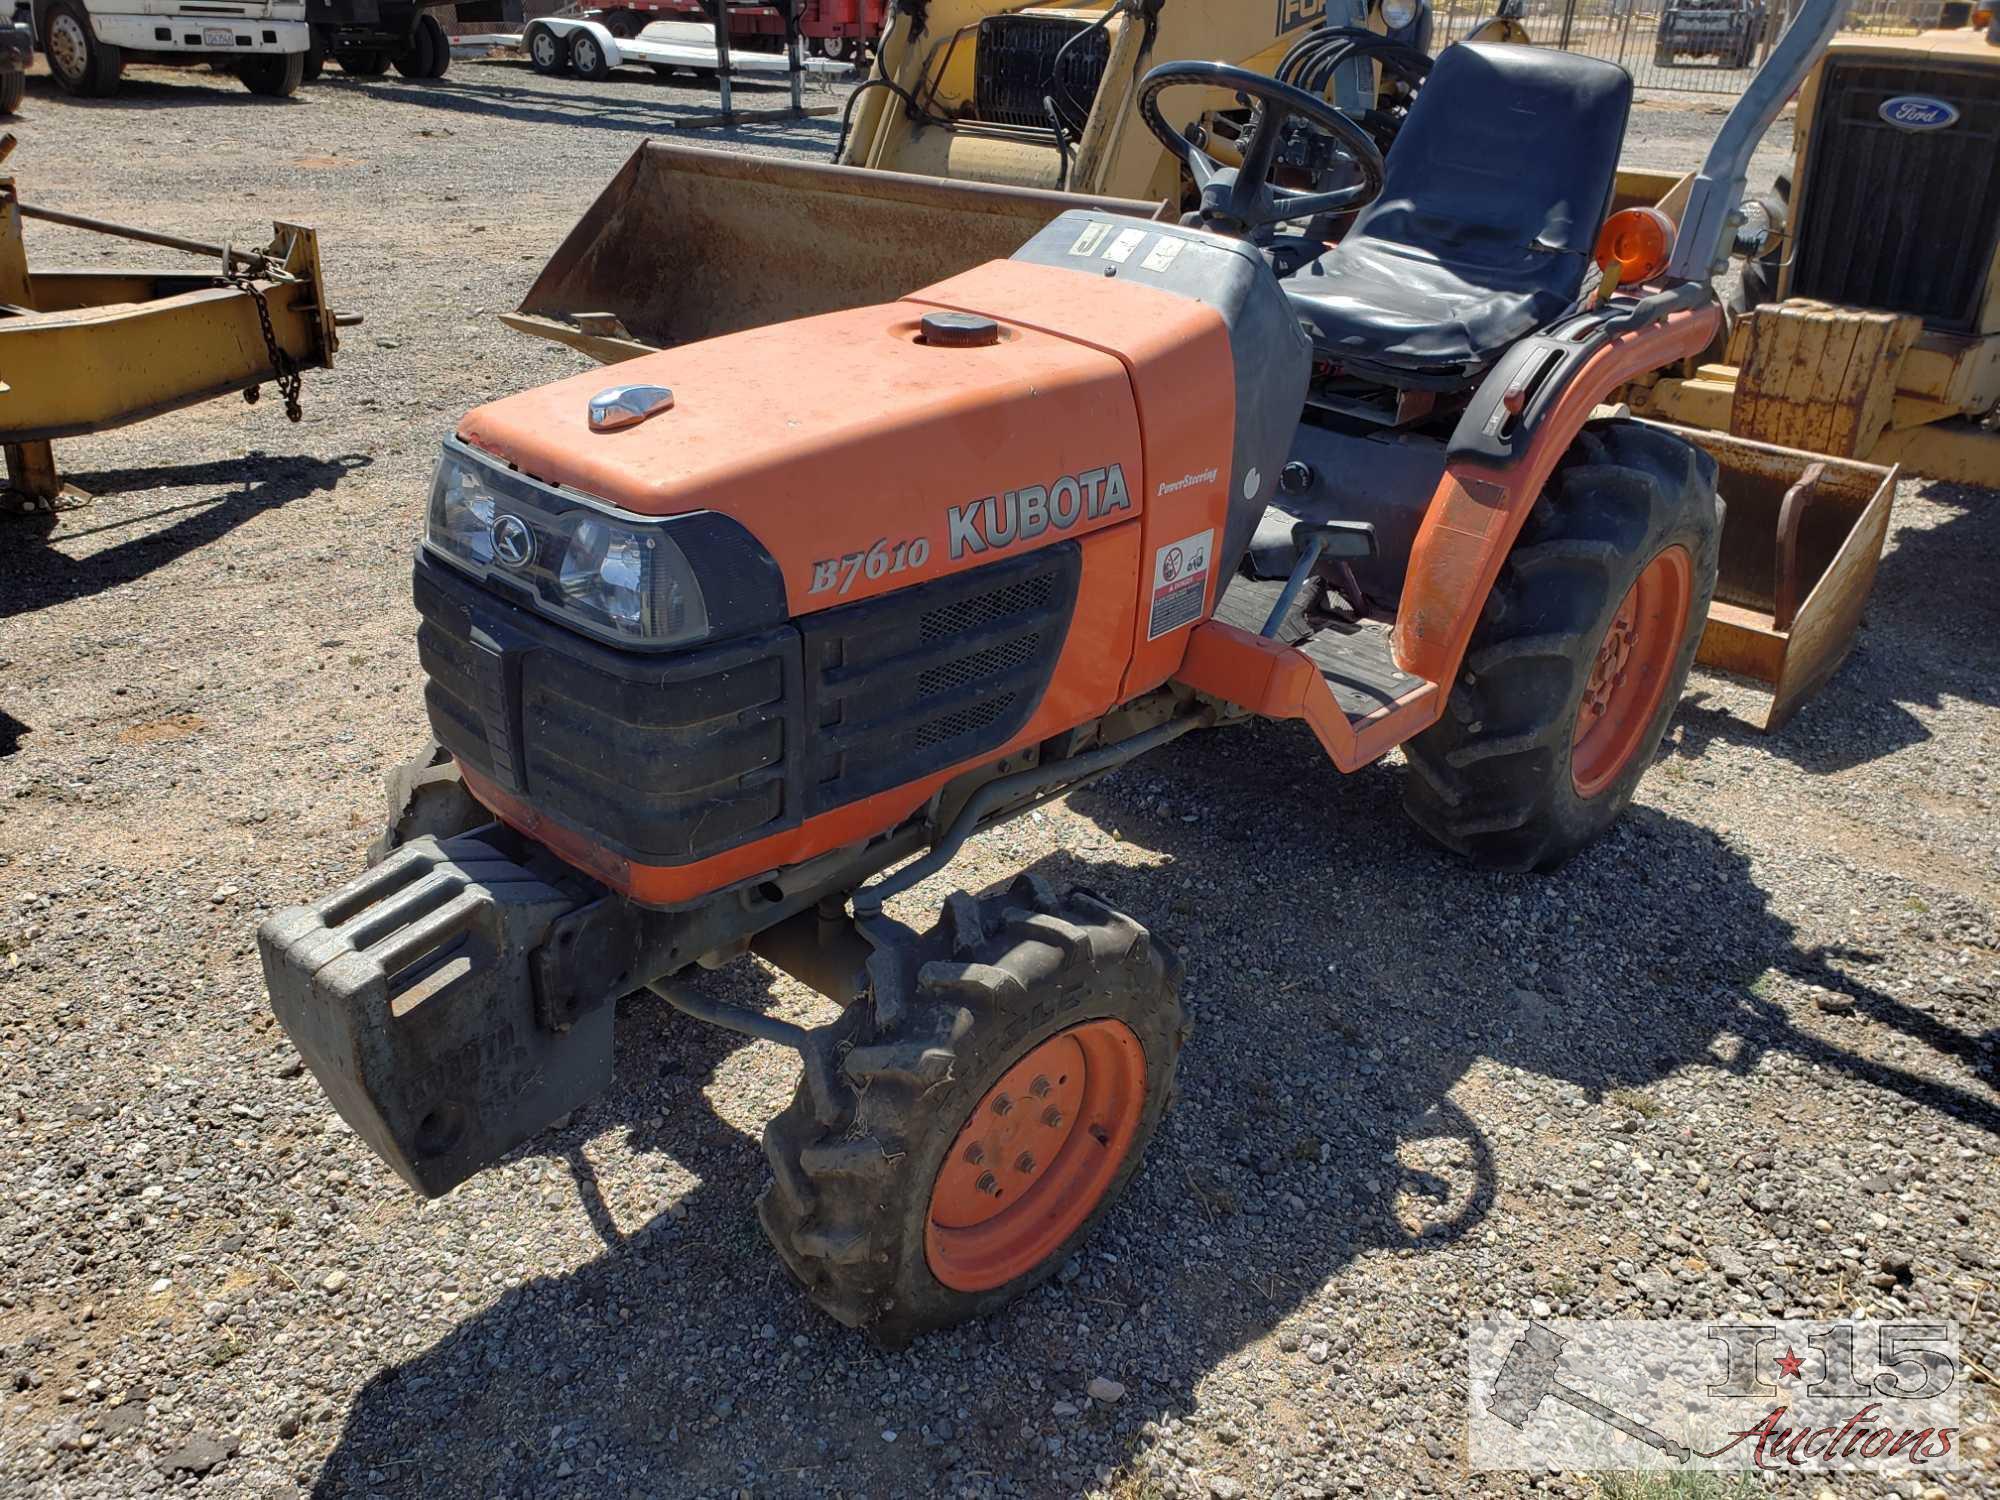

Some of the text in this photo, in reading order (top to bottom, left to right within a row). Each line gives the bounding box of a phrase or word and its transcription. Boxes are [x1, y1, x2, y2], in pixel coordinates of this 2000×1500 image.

[1894, 102, 1939, 122] Ford
[948, 463, 1131, 560] KUBOTA
[808, 537, 930, 595] B7610
